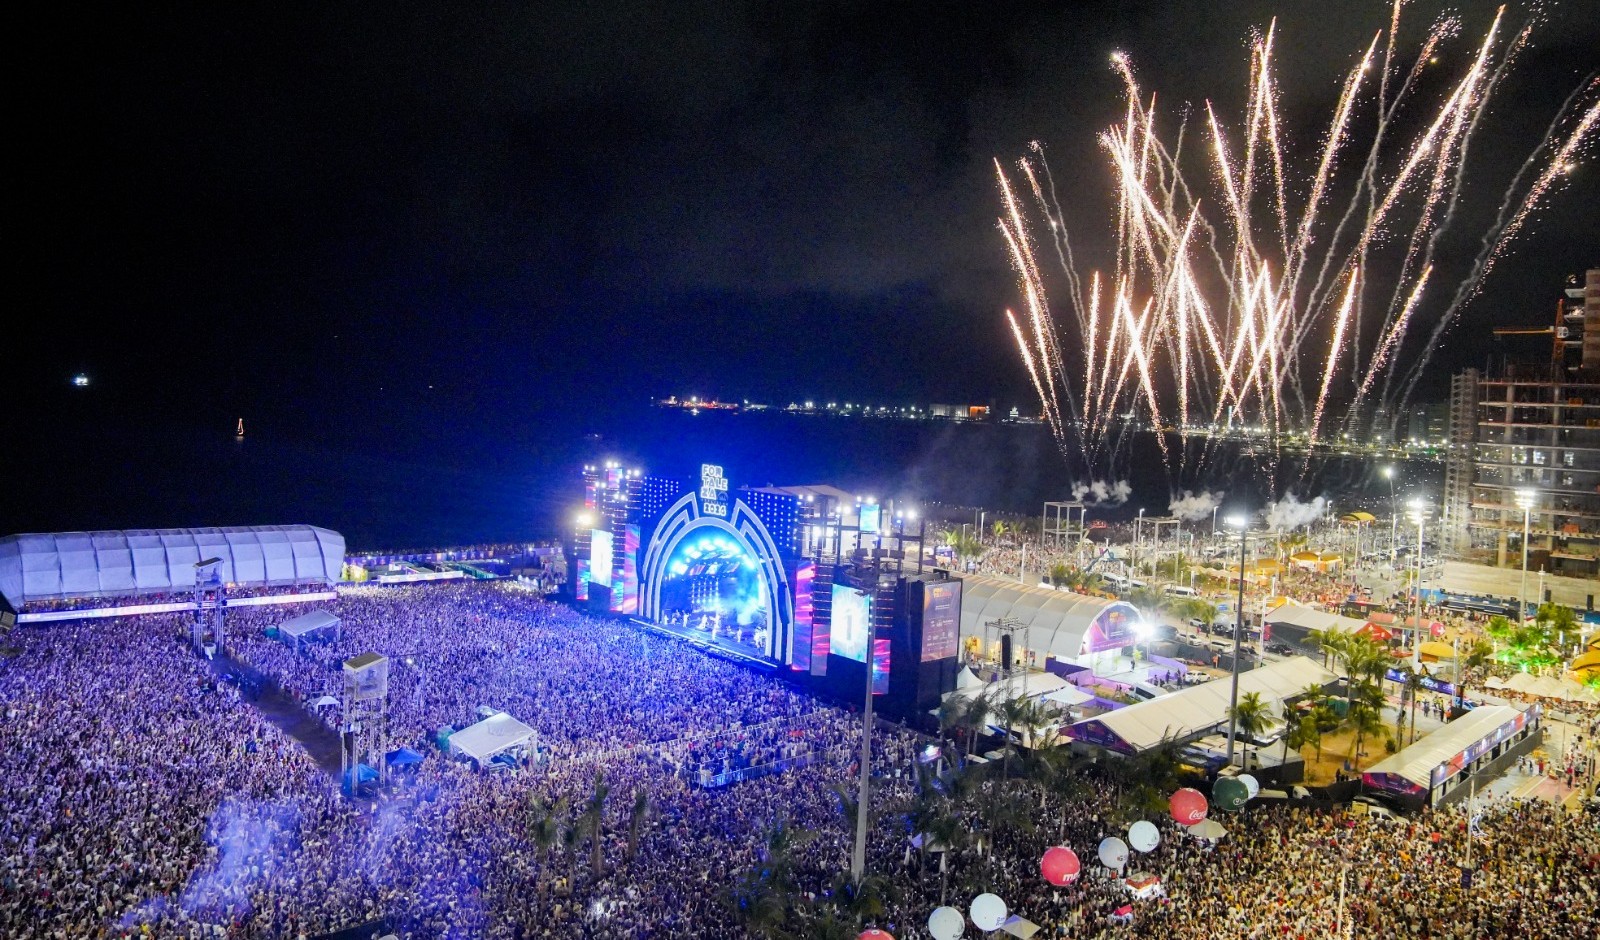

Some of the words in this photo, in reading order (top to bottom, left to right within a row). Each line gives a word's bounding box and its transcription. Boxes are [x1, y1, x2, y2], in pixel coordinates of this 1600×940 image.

[702, 464, 723, 478] FOR
[702, 475, 728, 491] TALE
[701, 486, 717, 500] ZA
